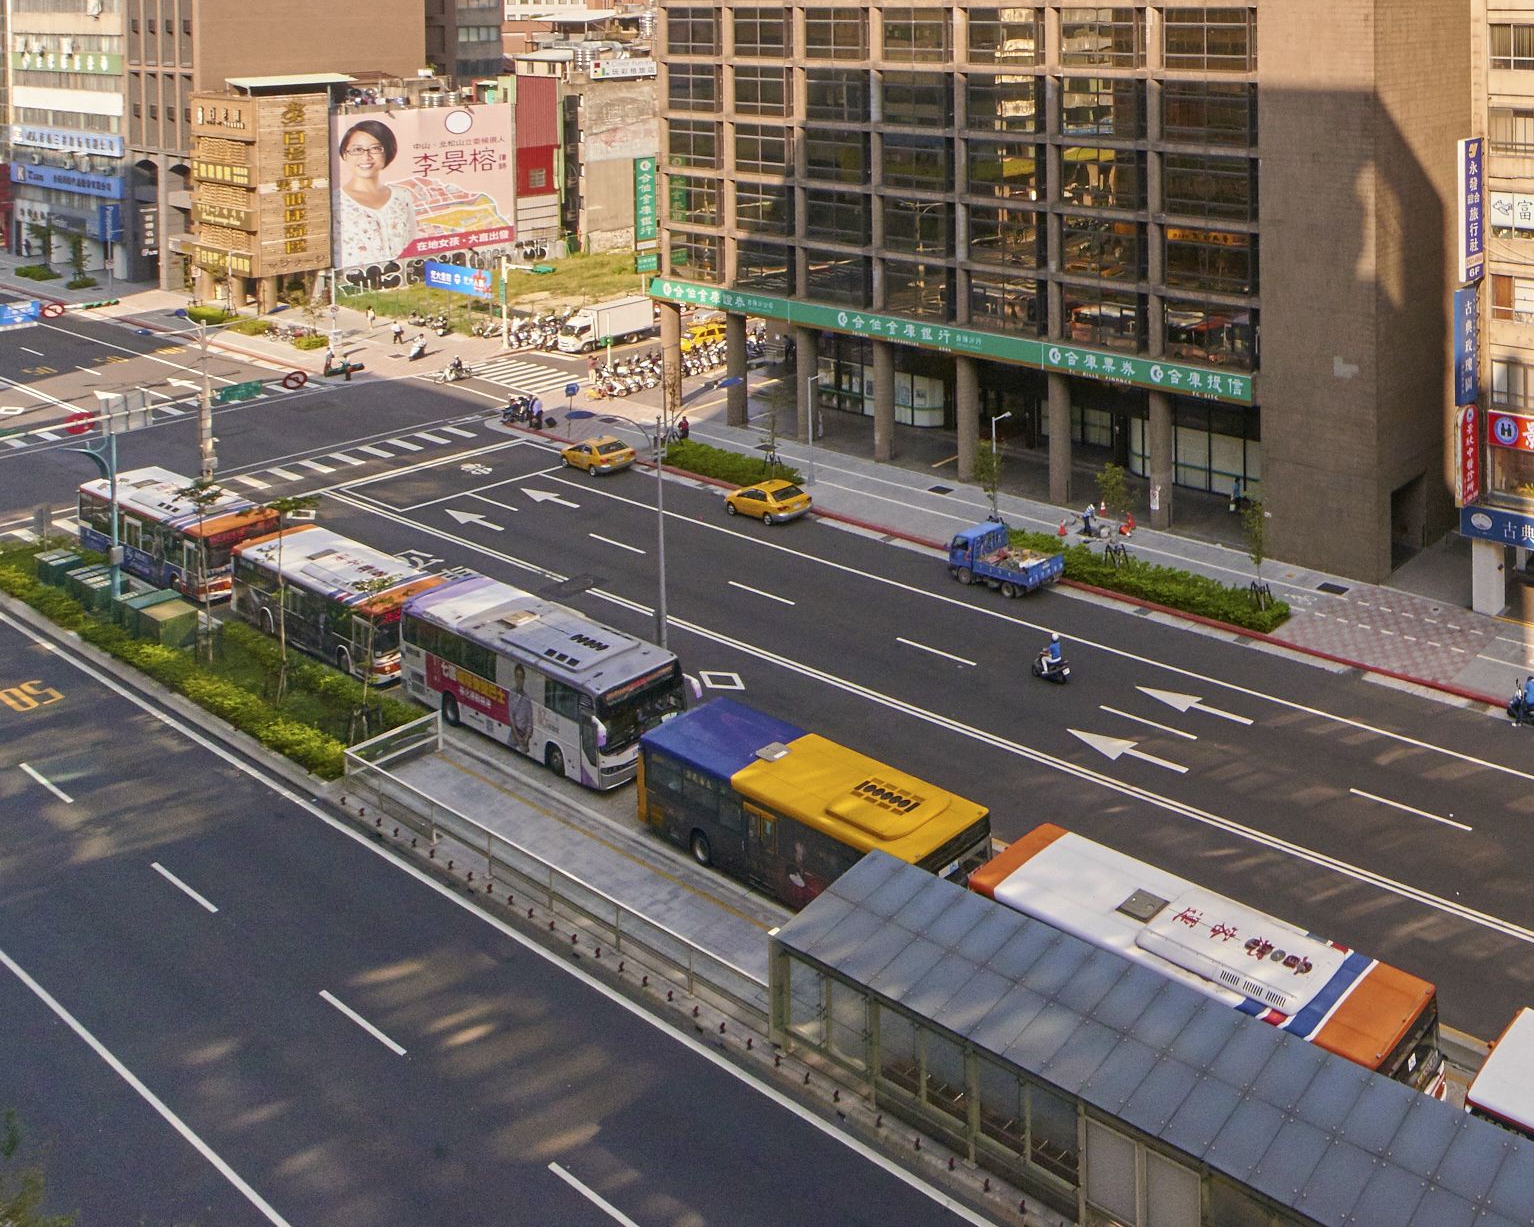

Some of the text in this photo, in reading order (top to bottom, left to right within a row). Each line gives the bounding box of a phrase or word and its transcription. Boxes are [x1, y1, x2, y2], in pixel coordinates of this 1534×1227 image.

[412, 146, 497, 177] 李晏榕
[852, 315, 951, 344] 合作金庫銀行
[1064, 351, 1136, 377] 合庫票券
[1168, 368, 1244, 396] 合庫投信
